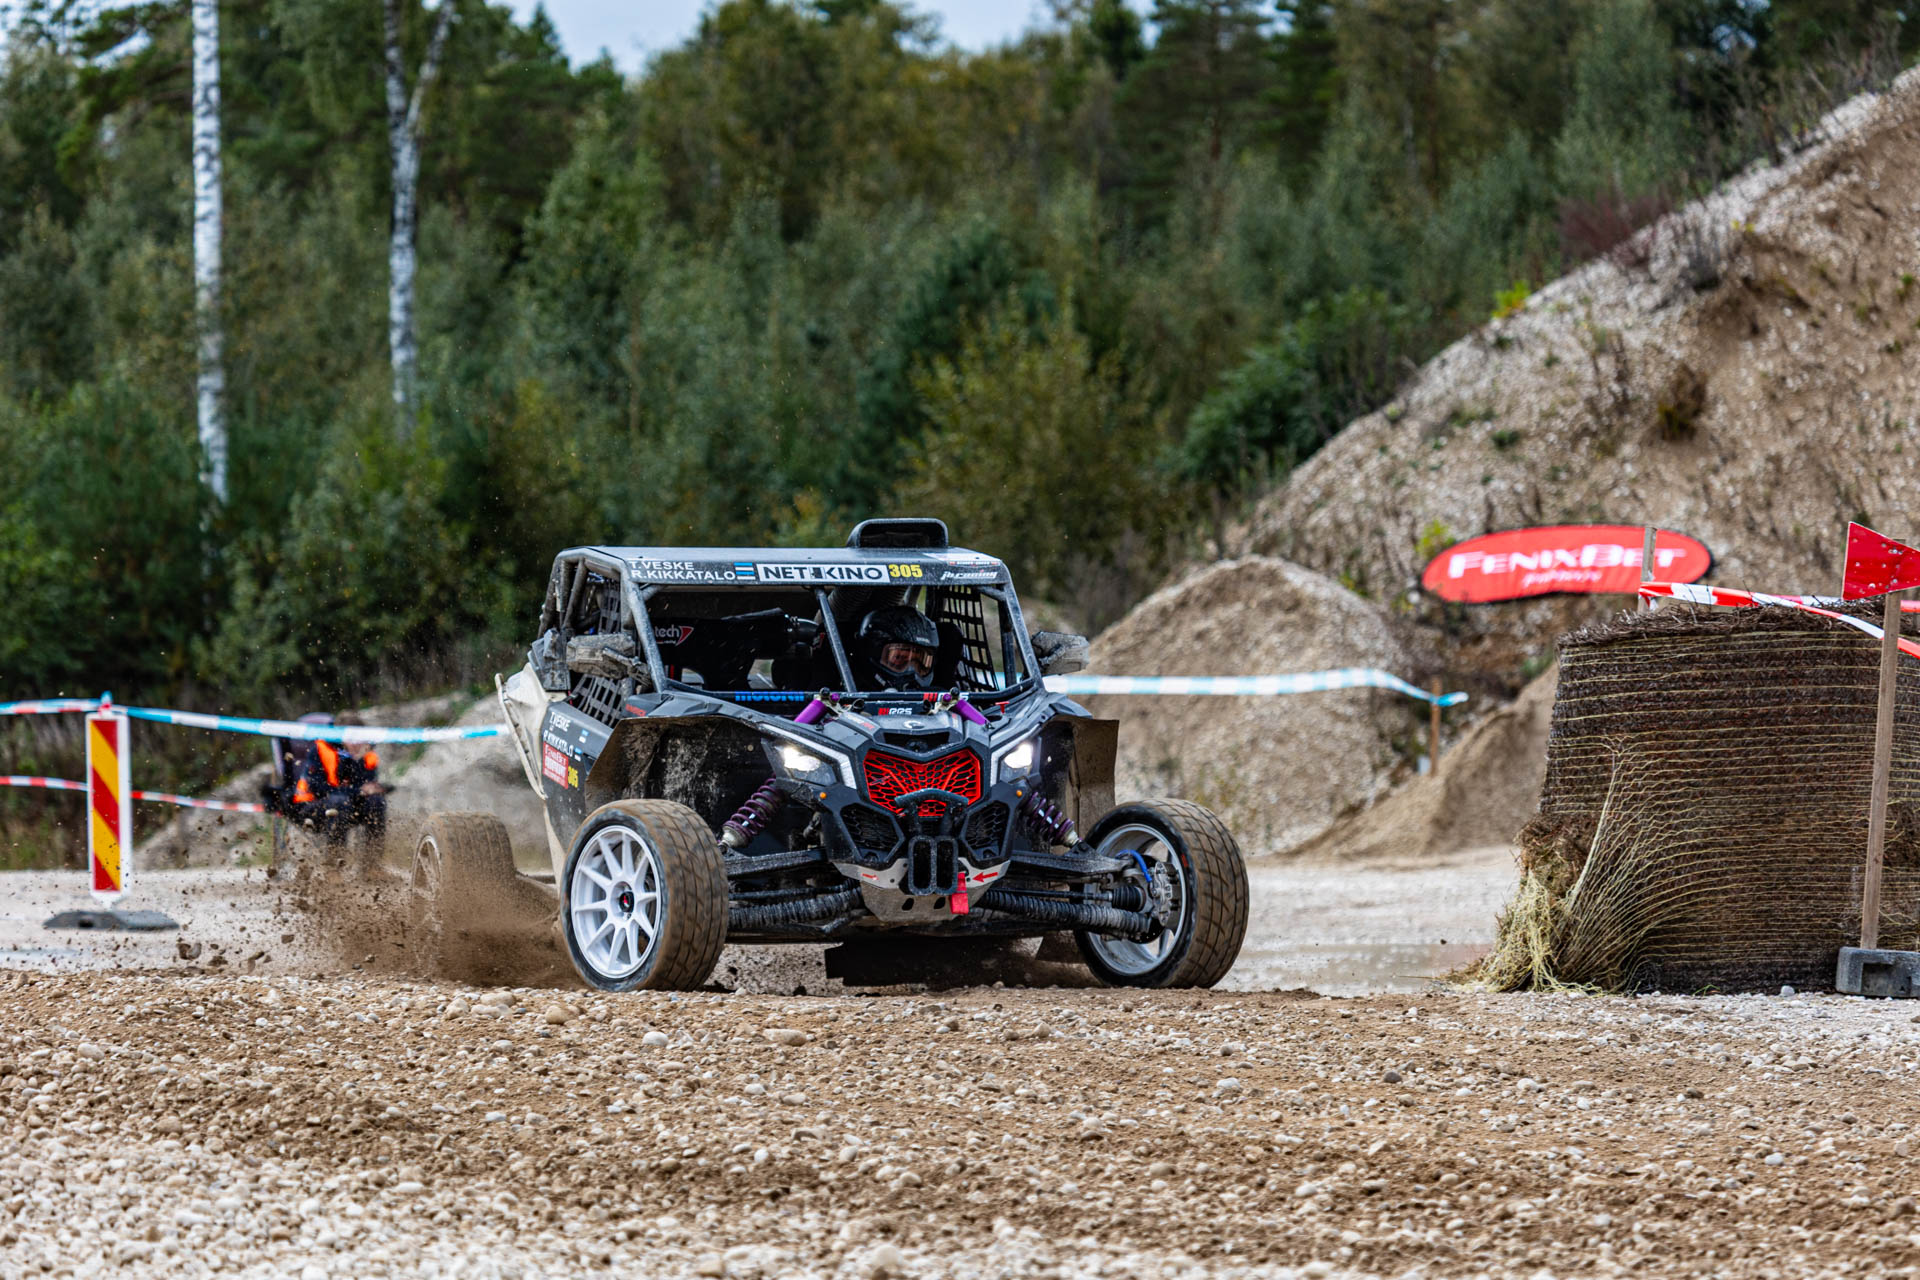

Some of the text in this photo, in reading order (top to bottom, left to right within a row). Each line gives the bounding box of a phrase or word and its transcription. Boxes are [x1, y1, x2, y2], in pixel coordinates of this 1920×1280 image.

[629, 561, 695, 571] T.VESKE
[889, 563, 923, 579] 305
[631, 570, 737, 581] R.KIKKATALO
